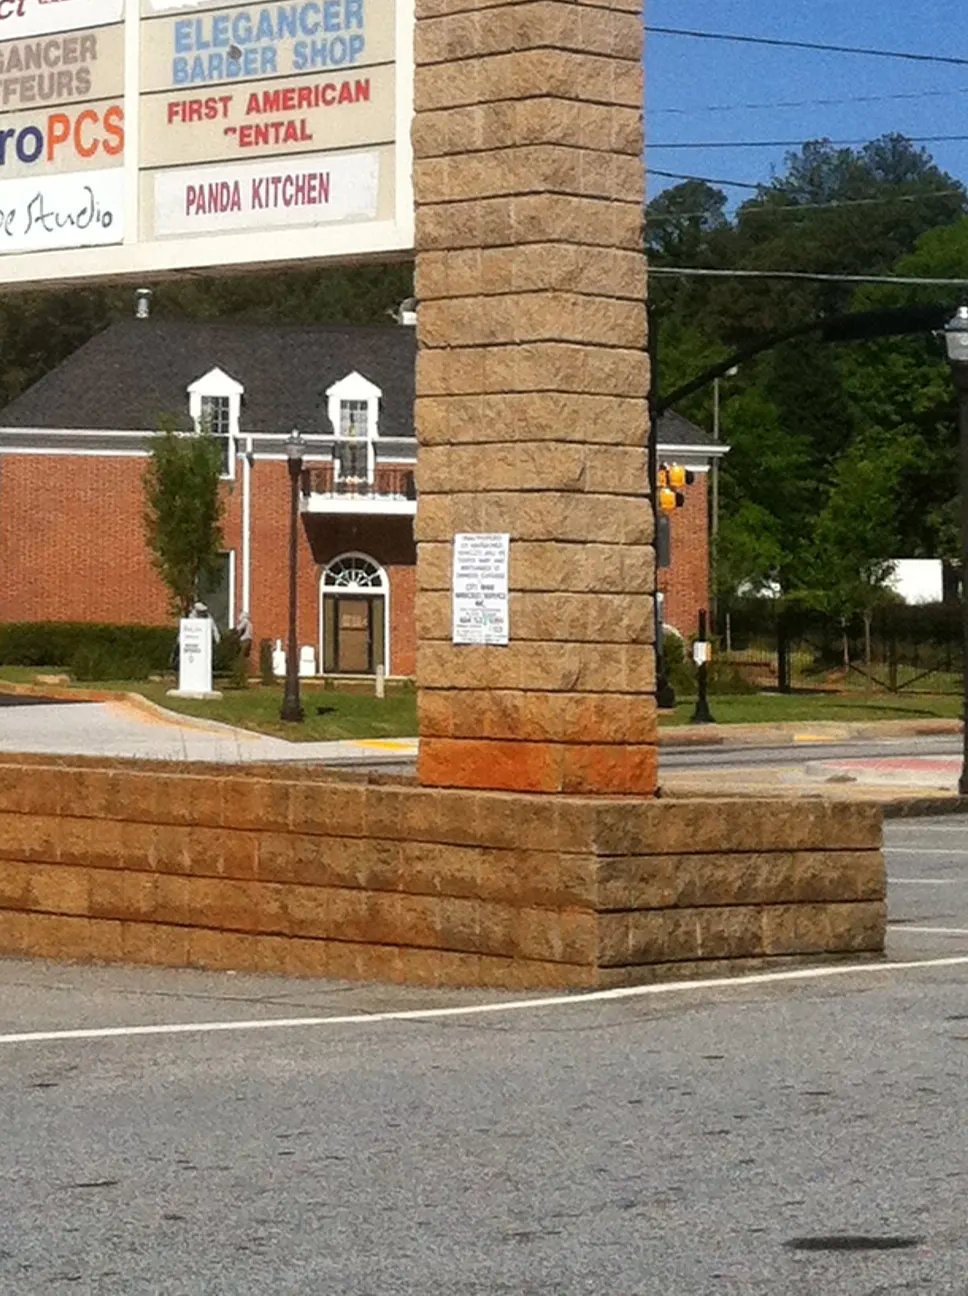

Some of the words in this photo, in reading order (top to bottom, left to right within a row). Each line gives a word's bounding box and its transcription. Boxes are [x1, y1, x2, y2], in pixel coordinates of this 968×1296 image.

[172, 46, 277, 85] BARBER
[292, 34, 365, 70] SHOP
[167, 96, 233, 124] FIRST
[245, 78, 370, 116] AMERICAN
[24, 185, 113, 234] Studio
[185, 180, 242, 216] PANDA
[251, 172, 330, 210] KITCHEN
